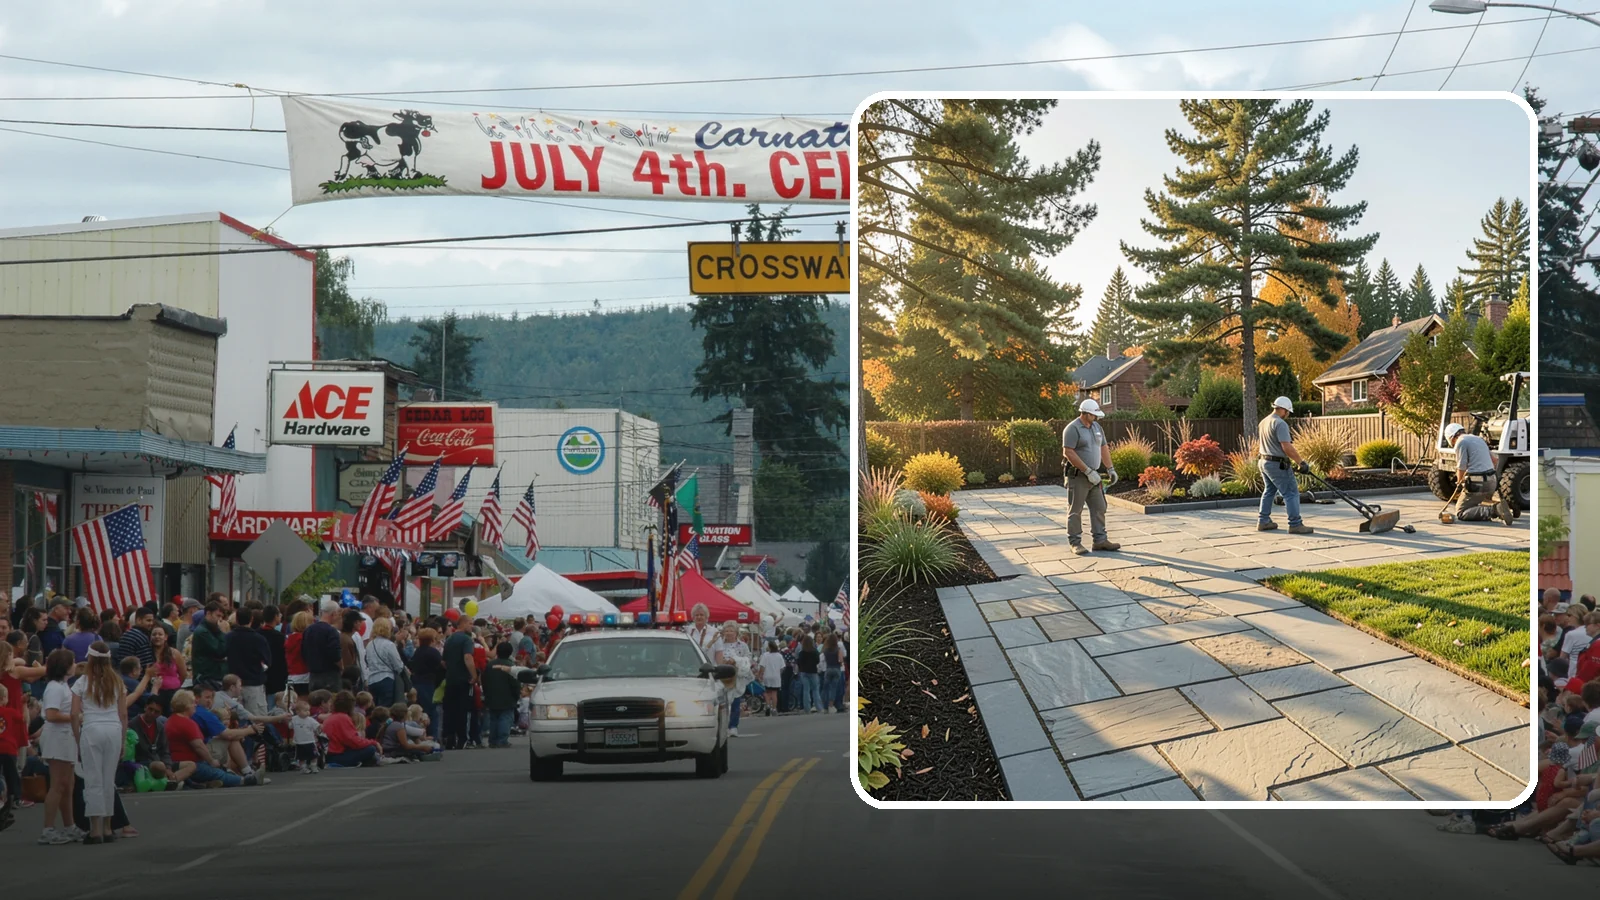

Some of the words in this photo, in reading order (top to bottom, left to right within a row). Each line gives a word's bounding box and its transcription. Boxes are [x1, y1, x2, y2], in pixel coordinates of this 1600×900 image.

[481, 141, 604, 192] JULY
[632, 149, 746, 197] 4th.
[696, 254, 850, 280] CROSSWA
[282, 379, 374, 420] ACE
[405, 409, 453, 422] CEDAR
[460, 409, 485, 422] LOG
[283, 420, 371, 437] Hardware
[416, 428, 477, 447] Coca-Cola
[83, 485, 93, 494] St.
[95, 485, 124, 495] Vincent
[126, 486, 136, 495] de
[137, 486, 155, 495] Paul
[688, 526, 742, 535] CRNATION
[699, 535, 731, 543] GLASS
